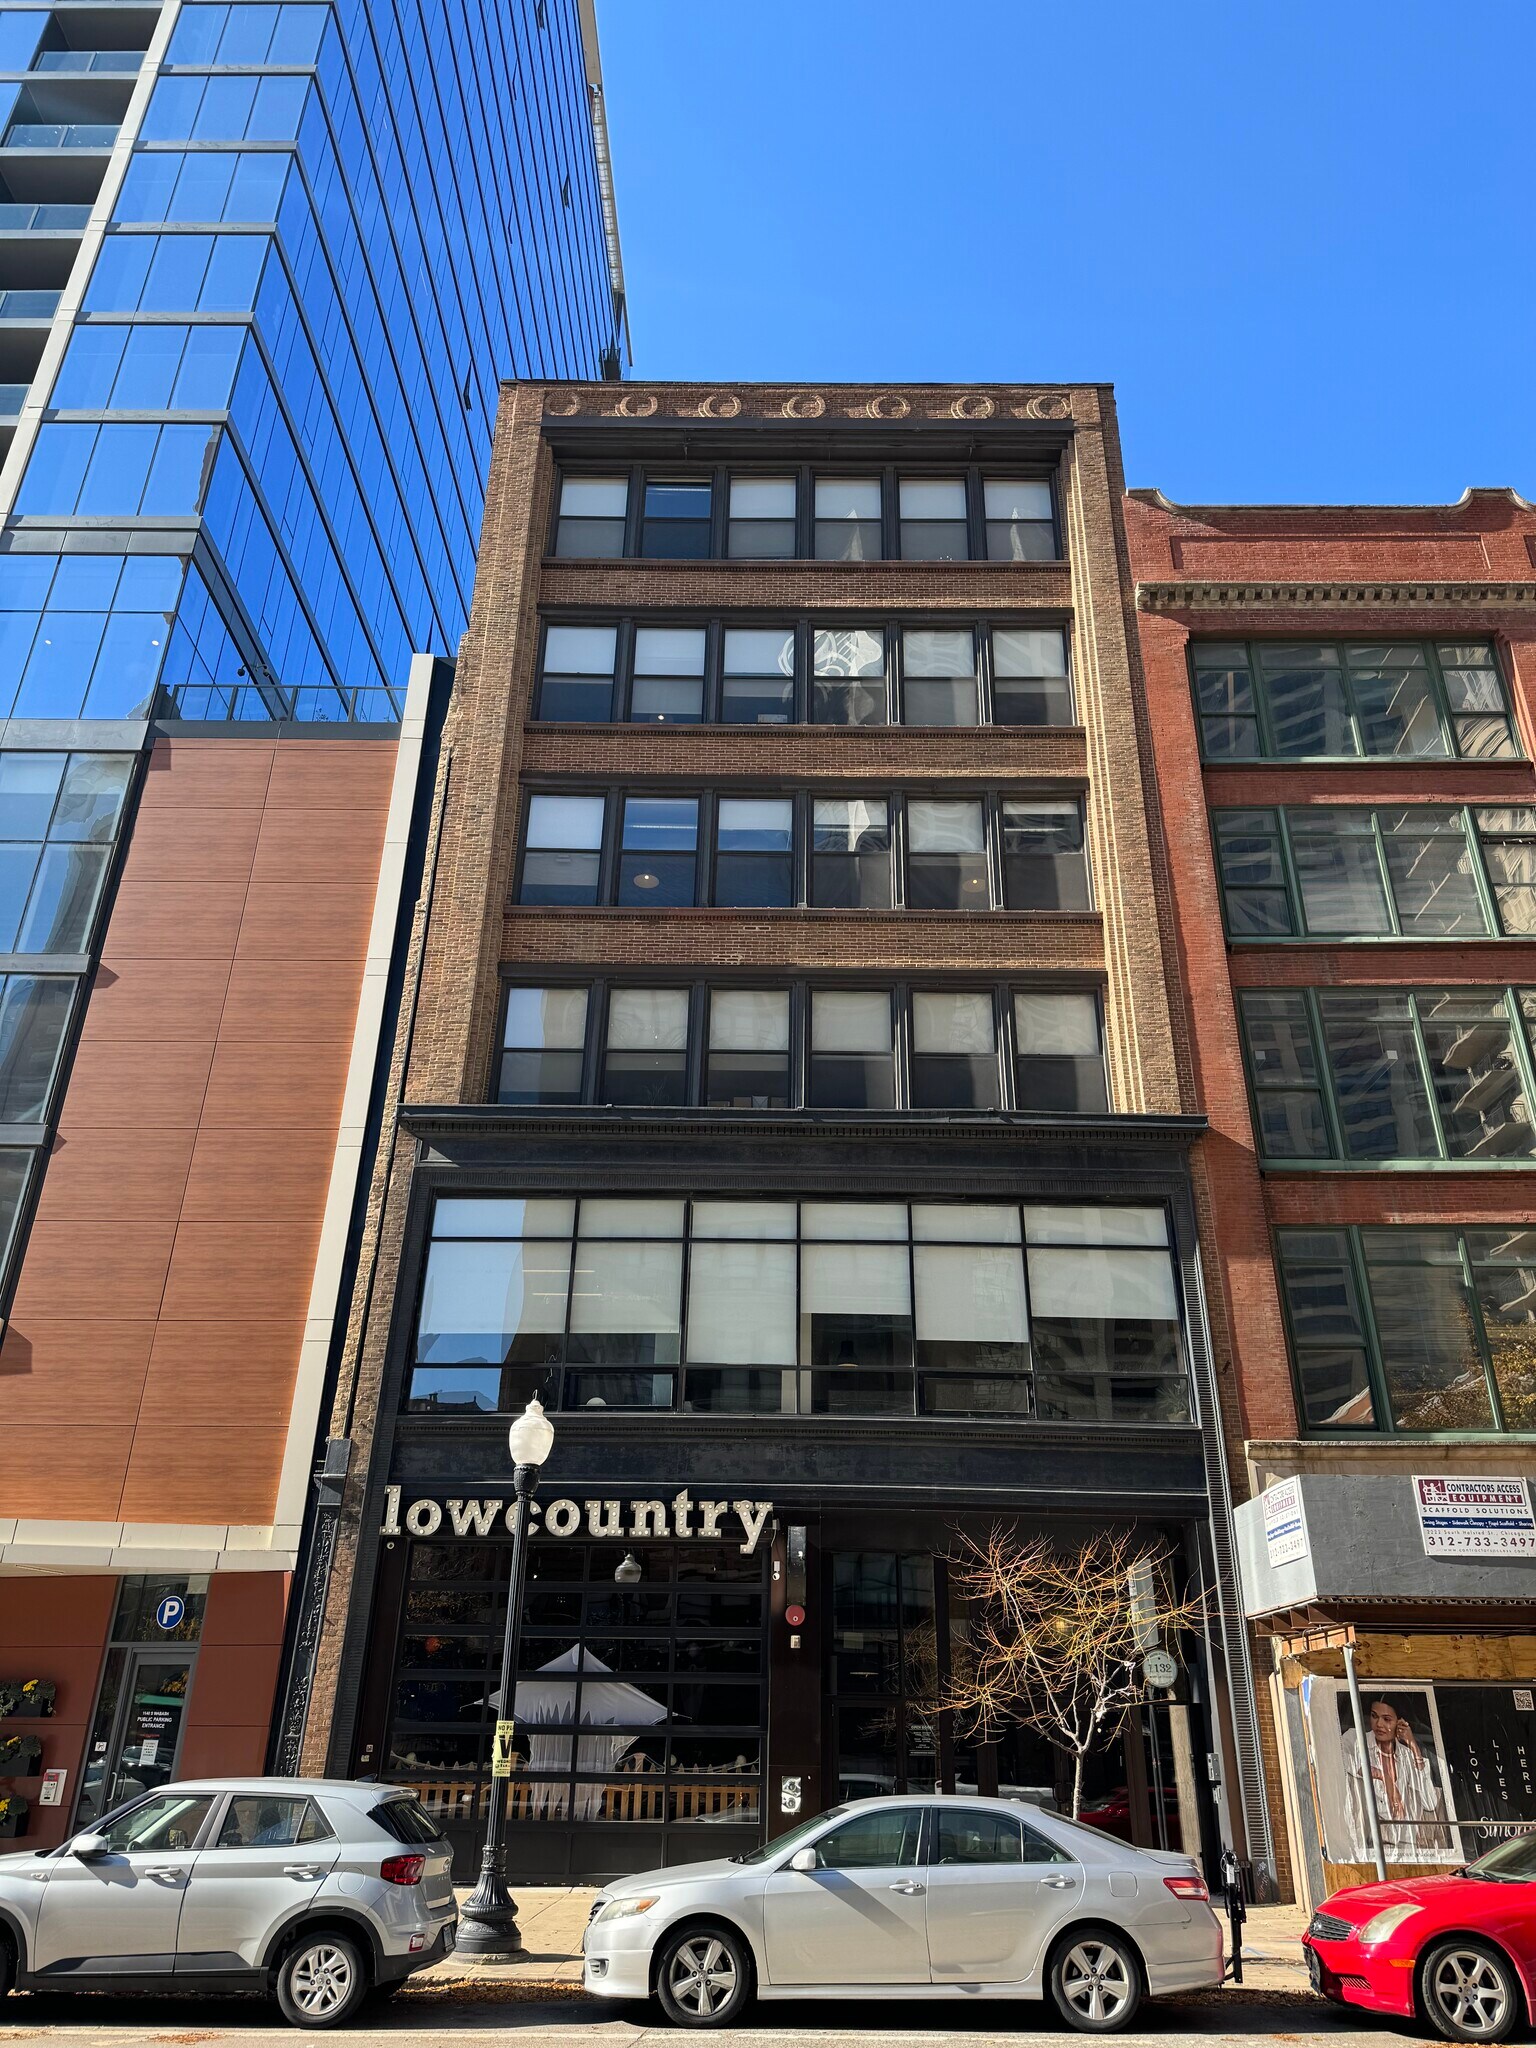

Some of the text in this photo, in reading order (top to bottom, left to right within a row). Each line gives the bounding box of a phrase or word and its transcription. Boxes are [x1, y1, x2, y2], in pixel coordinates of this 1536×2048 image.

[1446, 1483, 1521, 1493] CONTRACTORS ACCESS
[1452, 1494, 1519, 1503] EQUIPMENT
[379, 1484, 773, 1555] lowcountry
[1428, 1536, 1536, 1547] 312-733-3497
[162, 1601, 180, 1624] P
[1148, 1663, 1172, 1673] 1132
[1468, 1739, 1533, 1800] LOVE LIVES HERE
